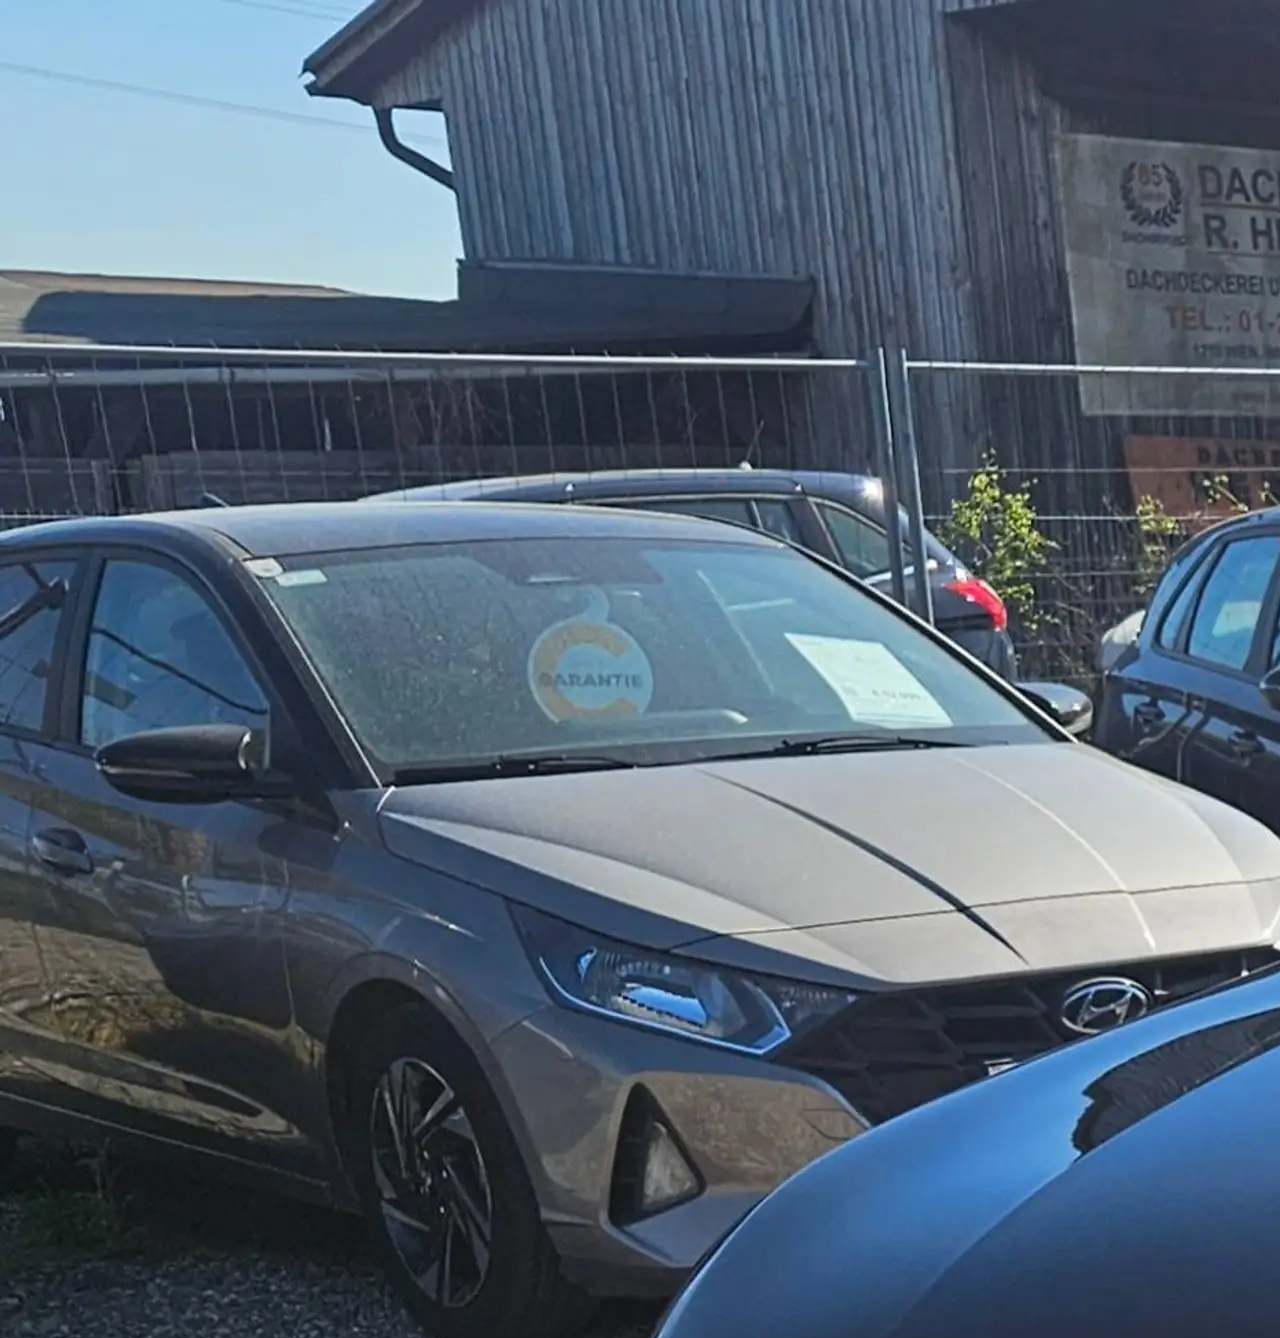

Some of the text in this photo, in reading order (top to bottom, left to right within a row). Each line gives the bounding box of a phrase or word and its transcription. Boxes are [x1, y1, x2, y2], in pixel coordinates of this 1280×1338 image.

[1203, 213, 1239, 249] R.
[1125, 268, 1264, 296] DACHDECKEREI
[1164, 304, 1231, 333] TEL.:
[538, 671, 644, 689] GARANTIE
